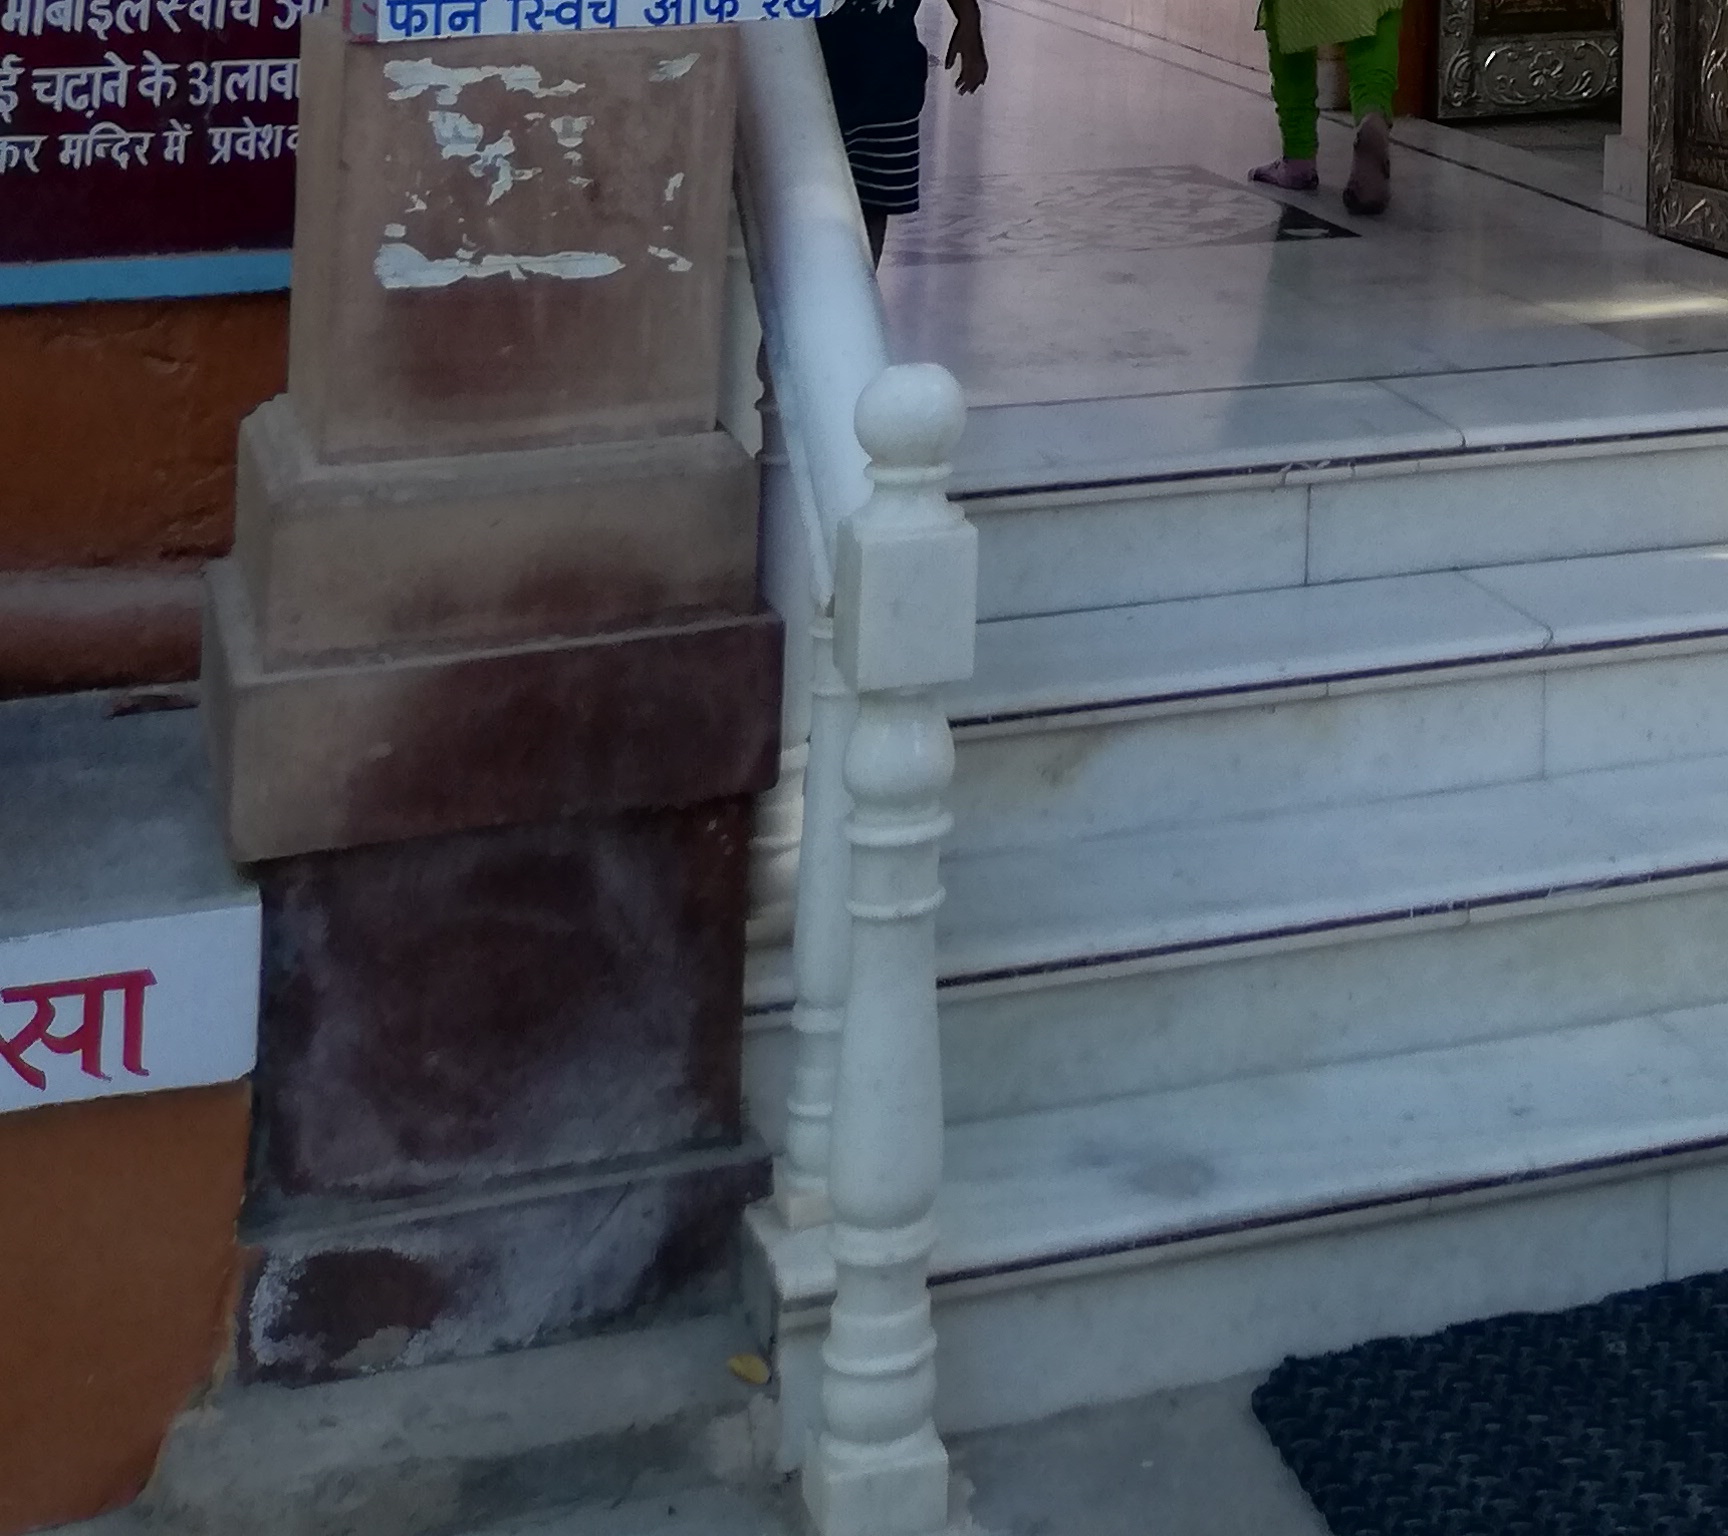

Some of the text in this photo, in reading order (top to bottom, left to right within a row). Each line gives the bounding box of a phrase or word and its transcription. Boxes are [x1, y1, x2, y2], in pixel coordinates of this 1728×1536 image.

[137, 49, 181, 107] के
[58, 121, 155, 170] मन्दिर
[162, 118, 193, 165] में
